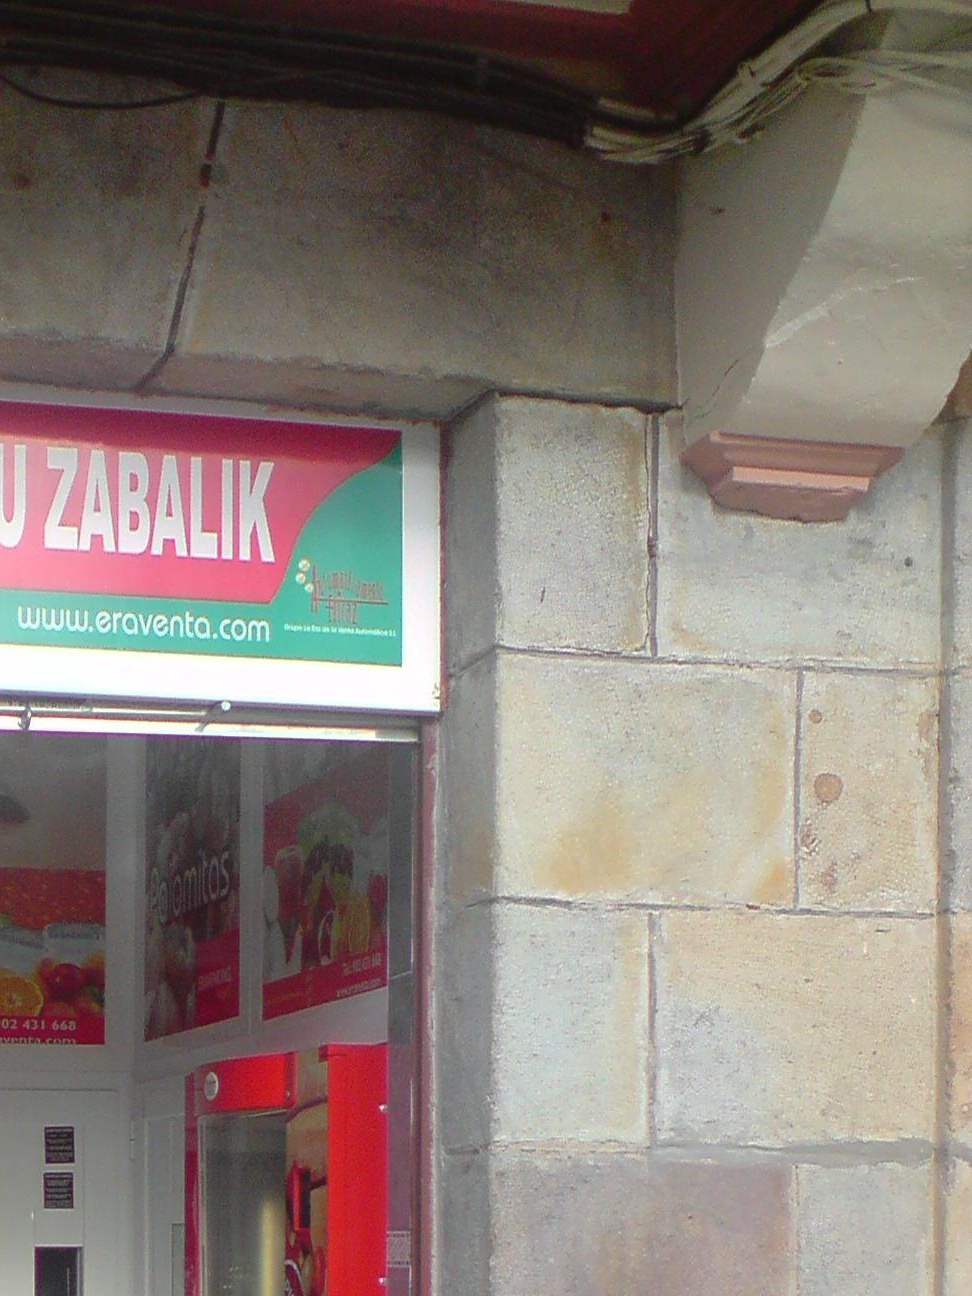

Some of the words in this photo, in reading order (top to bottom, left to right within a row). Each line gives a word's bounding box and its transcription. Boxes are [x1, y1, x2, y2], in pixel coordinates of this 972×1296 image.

[44, 446, 276, 563] ZABALIK
[17, 606, 271, 642] www.eraventa.com
[22, 1018, 46, 1031] 431
[52, 1020, 77, 1031] 668
